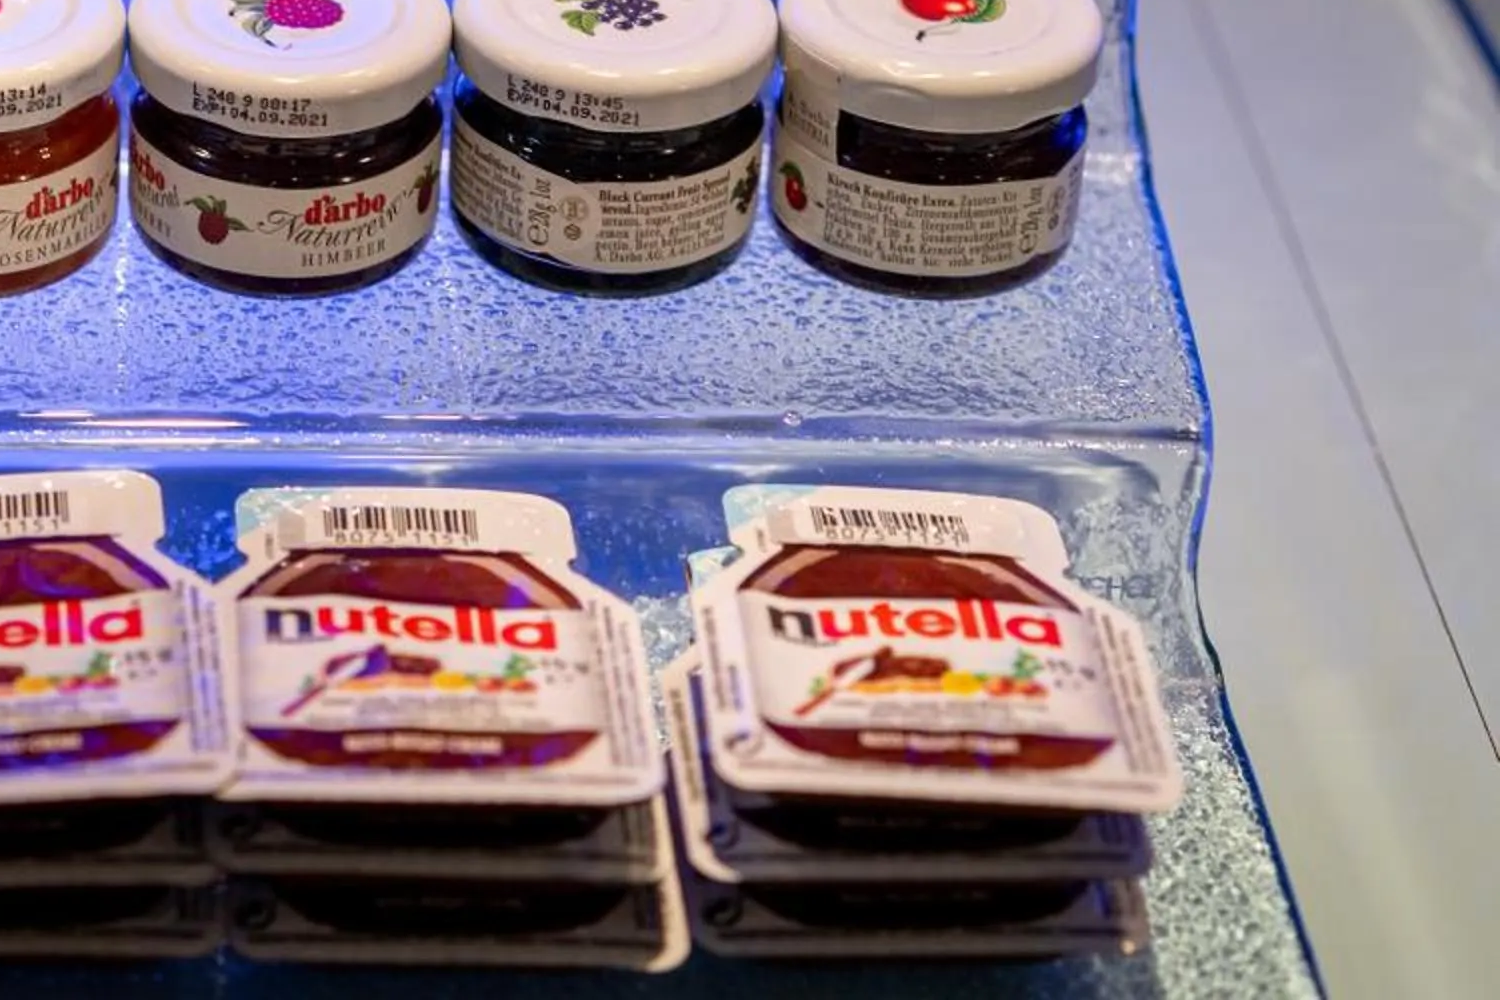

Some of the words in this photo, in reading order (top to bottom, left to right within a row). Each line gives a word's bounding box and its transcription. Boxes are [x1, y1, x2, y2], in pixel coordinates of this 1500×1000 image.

[0, 81, 47, 103] 13:14
[192, 79, 202, 97] L
[242, 93, 254, 108] 9
[506, 86, 640, 127] EXP:04.09.2021
[507, 72, 517, 88] L
[521, 78, 549, 98] 248
[554, 89, 566, 101] 9
[574, 92, 624, 111] 13:45
[192, 96, 328, 127] EXP:04.09.2021
[25, 176, 94, 220] d'arbo
[303, 191, 388, 226] d'arbo
[599, 189, 630, 203] Black
[301, 239, 387, 268] HIMBEER
[3, 518, 61, 535] 1151
[264, 603, 558, 651] nutella
[767, 597, 1063, 647] nutella
